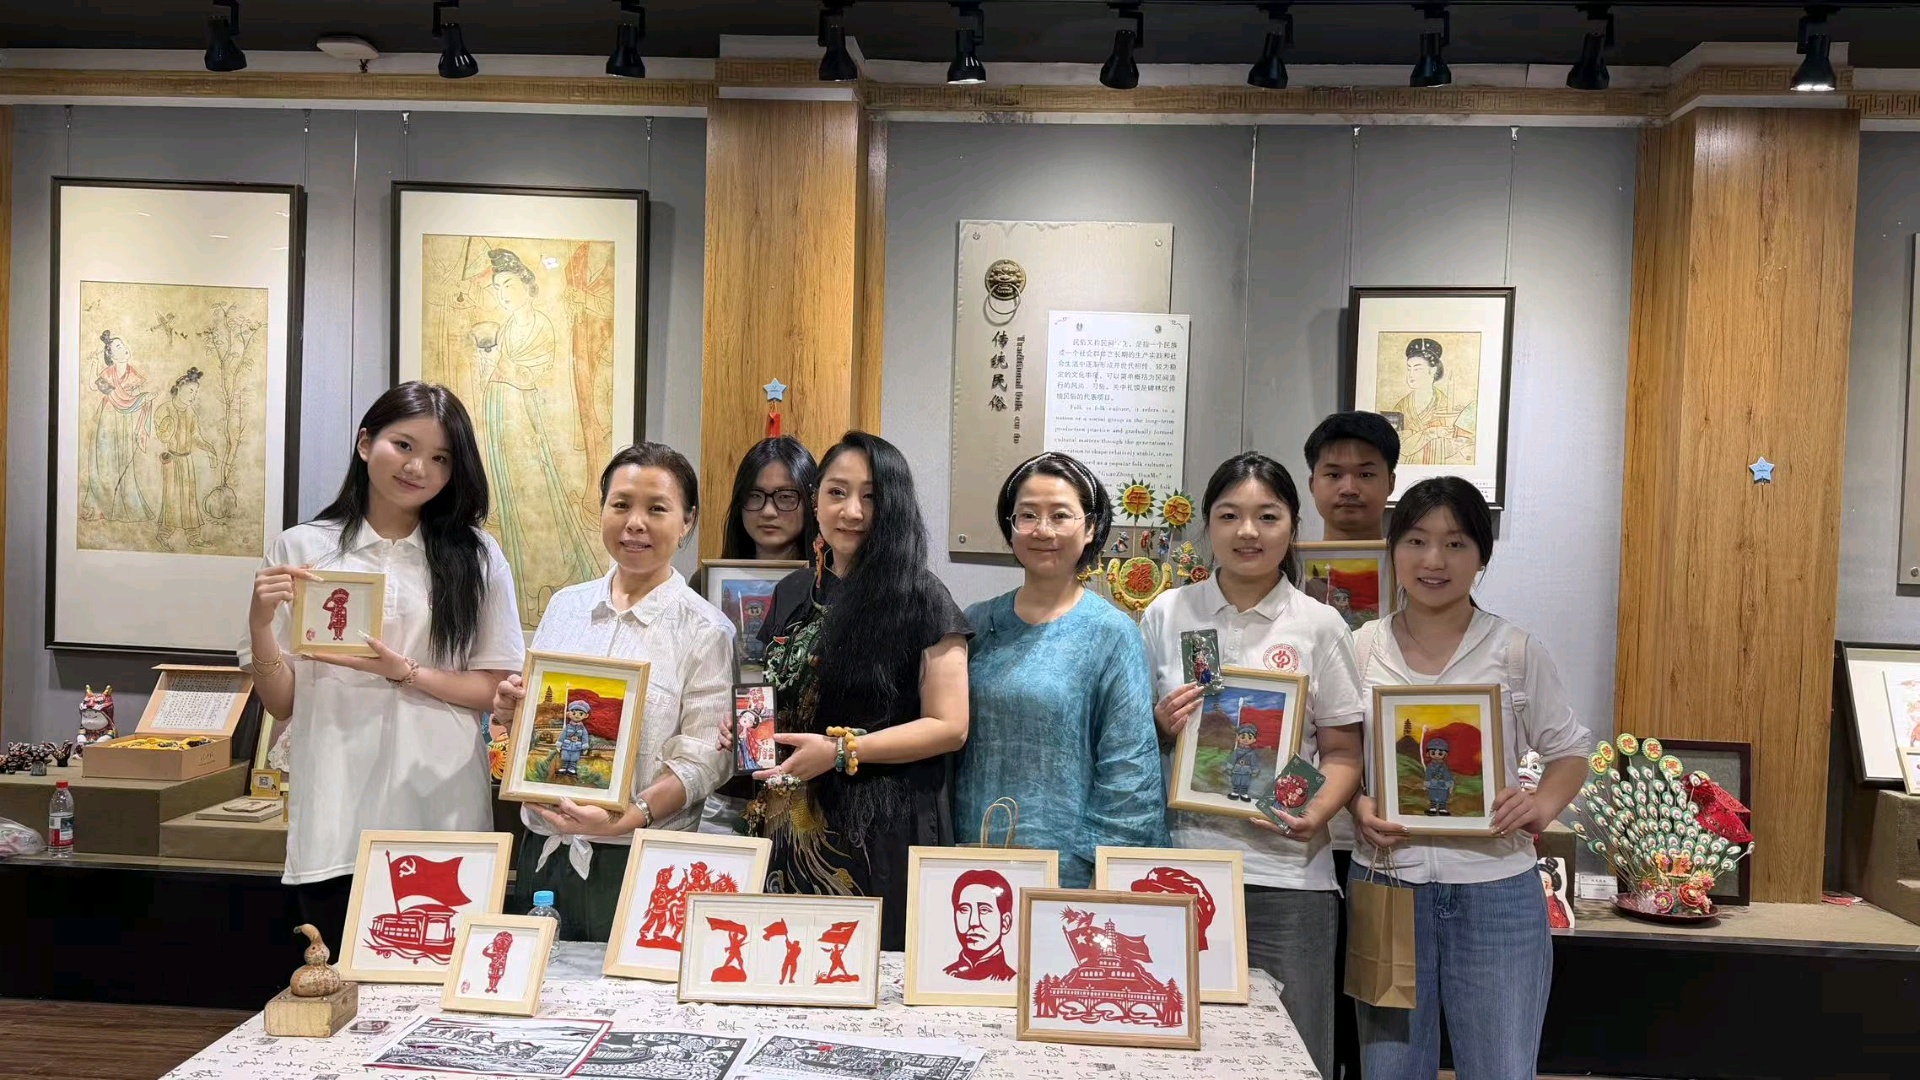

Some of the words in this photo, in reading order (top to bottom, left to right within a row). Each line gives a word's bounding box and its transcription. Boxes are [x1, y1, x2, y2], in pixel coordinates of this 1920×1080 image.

[988, 330, 1009, 412] 传统民俗
[1126, 488, 1148, 514] 年
[1165, 499, 1190, 523] 好
